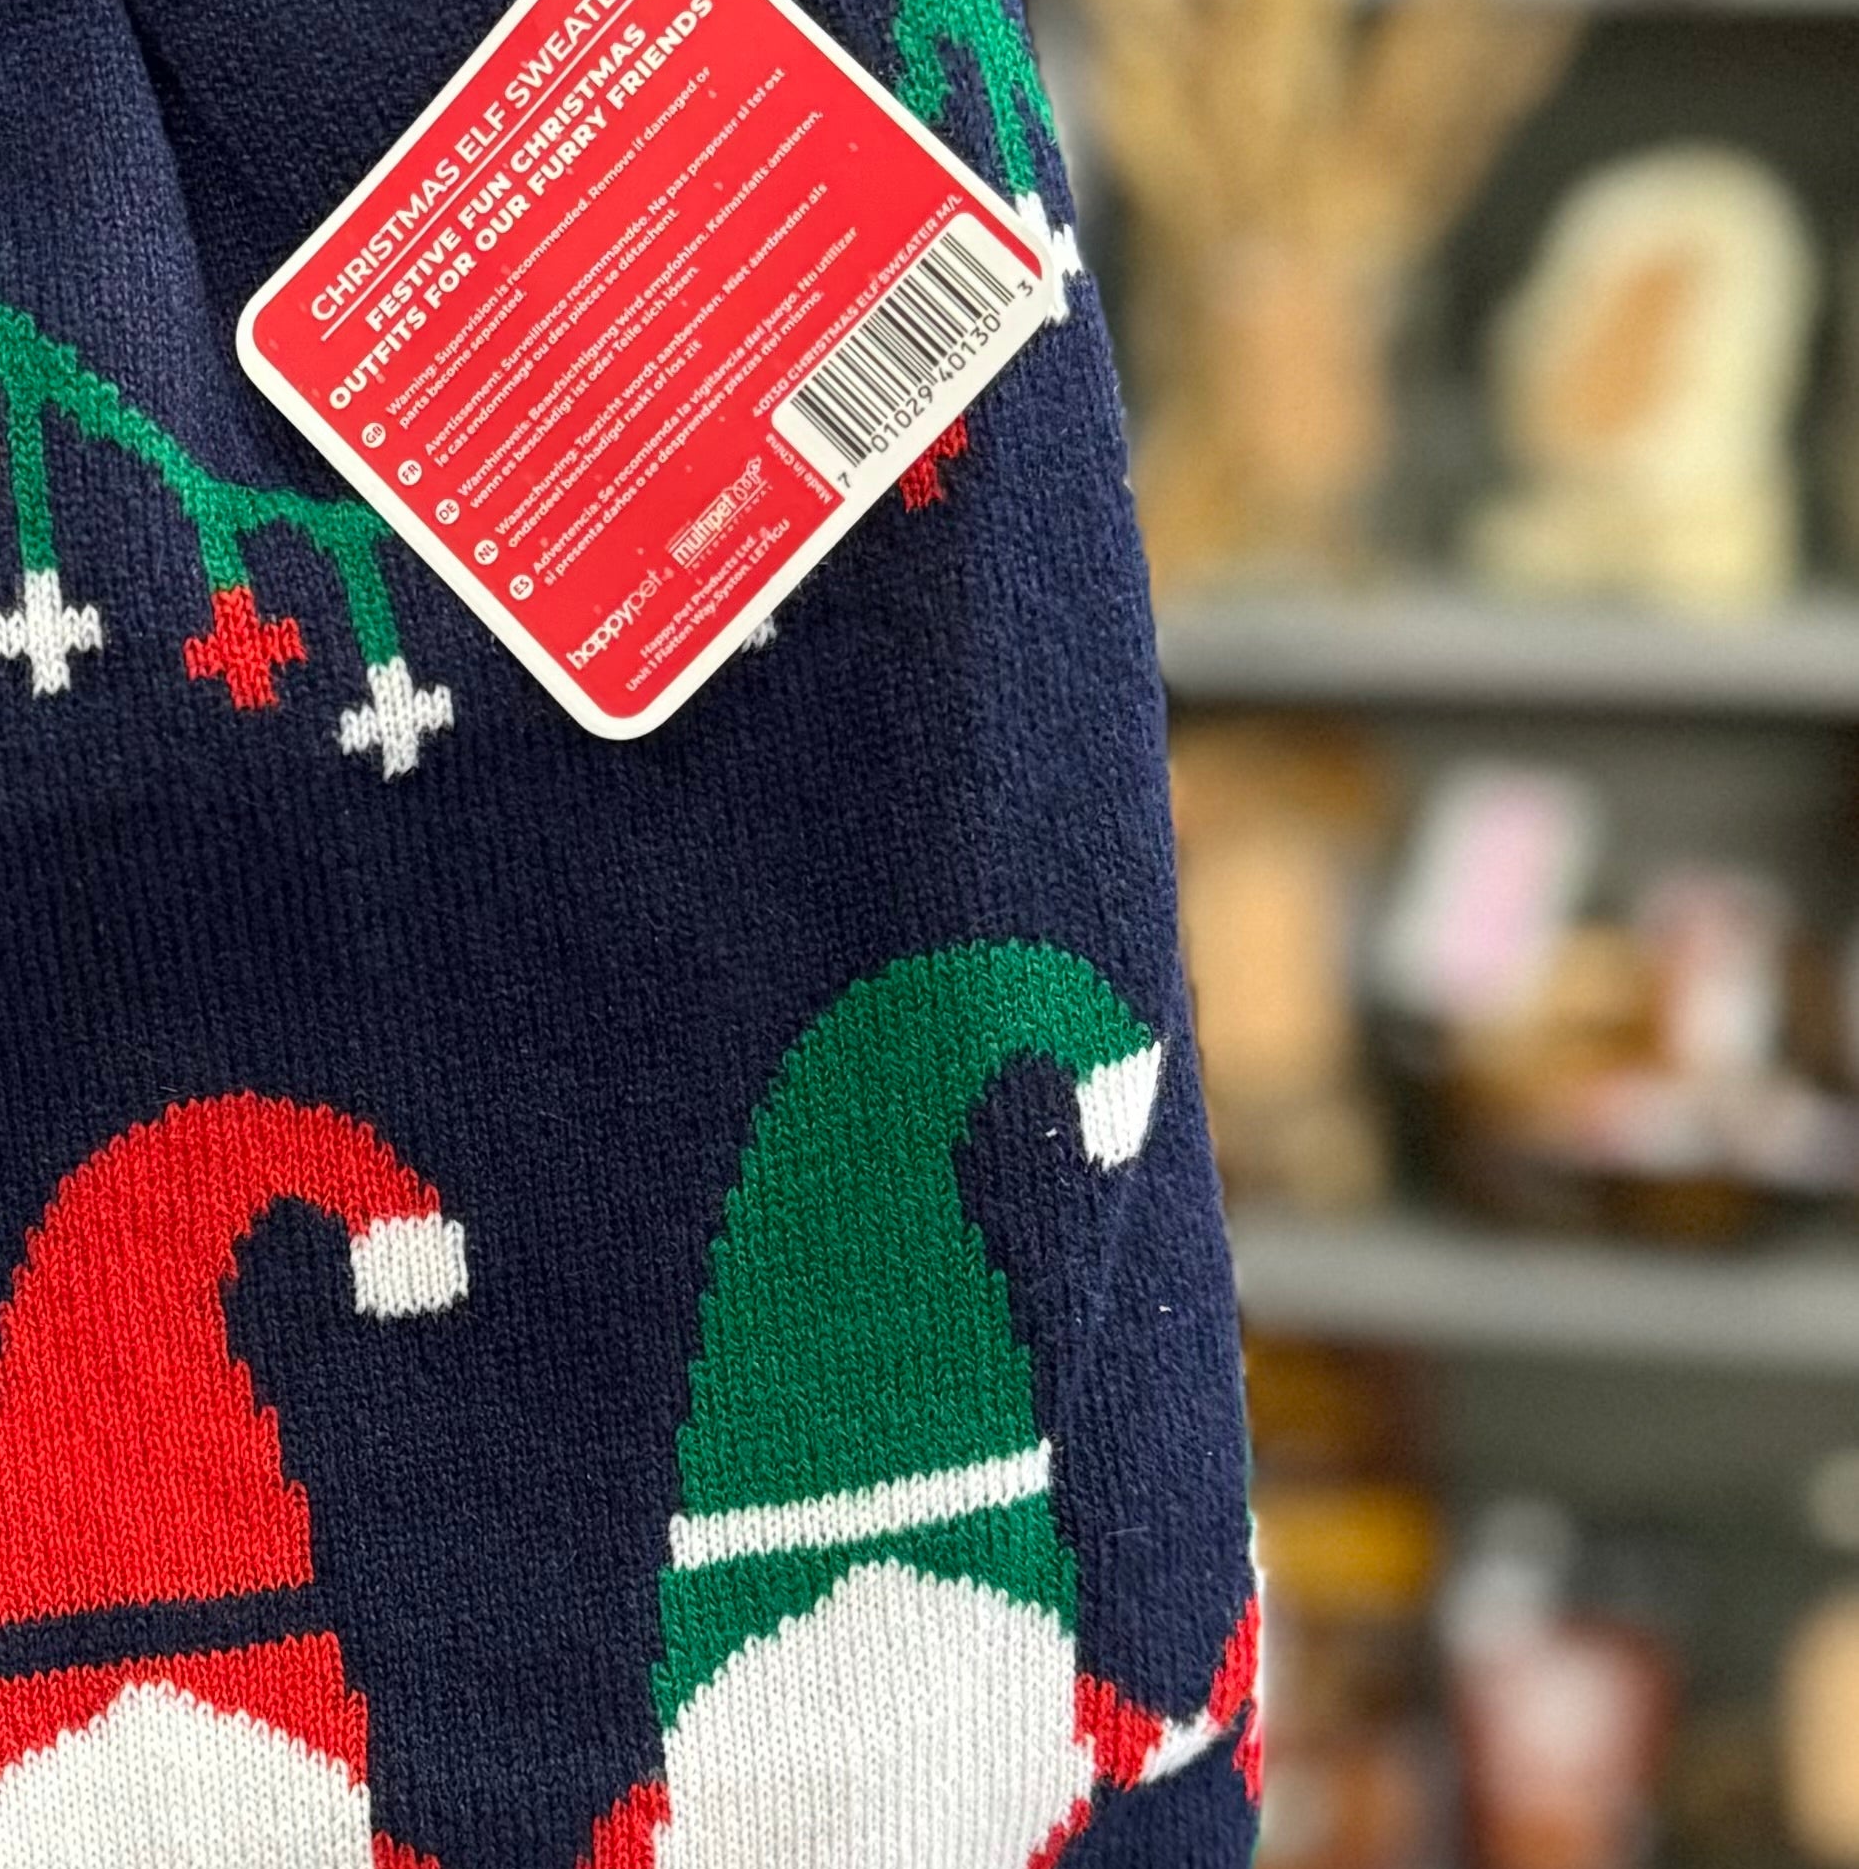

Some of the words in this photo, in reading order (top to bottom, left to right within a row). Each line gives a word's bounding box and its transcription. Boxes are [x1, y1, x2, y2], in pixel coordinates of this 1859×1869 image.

[311, 158, 460, 321] CHRISTMAS
[454, 100, 506, 164] ELF
[329, 305, 427, 410] OUTFITS
[423, 251, 477, 309] FOR
[475, 194, 531, 252] OUR
[526, 105, 607, 196] FURRY
[365, 226, 462, 332] FESTIVE
[457, 171, 513, 230] FUN
[510, 23, 646, 173] CHRISTMAS
[385, 363, 438, 415] Warning:
[434, 295, 499, 365] Supervision
[494, 284, 509, 298] is
[506, 197, 591, 286] recommended.
[587, 149, 636, 200] Remove
[632, 136, 645, 152] if
[643, 79, 698, 141] damaged
[695, 66, 710, 83] or
[425, 370, 504, 456] Avertissement:
[500, 298, 568, 372] Surveillance
[566, 215, 651, 301] recommandée.
[647, 195, 668, 215] Ne
[665, 173, 690, 199] pas
[736, 105, 750, 121] si
[746, 86, 767, 109] tel
[764, 67, 785, 91] est
[399, 395, 430, 430] parts
[425, 349, 472, 398] become
[470, 288, 527, 351] separated.
[433, 453, 450, 468] le
[447, 432, 469, 455] cas
[466, 358, 534, 435] endommagé
[532, 342, 550, 362] ou
[547, 320, 571, 345] des
[567, 283, 607, 325] pièces
[604, 269, 620, 285] se
[618, 208, 679, 271] détachent.
[457, 420, 532, 496] Warnhinweis:
[528, 324, 620, 421] Beaufsichtigung
[614, 295, 646, 326] wird
[643, 233, 709, 299] empfohlen.
[470, 474, 503, 509] wenn
[501, 459, 517, 476] es
[512, 395, 575, 462] beschädigt
[570, 378, 590, 398] ist
[587, 350, 615, 381] oder
[611, 323, 643, 352] Teile
[640, 298, 667, 326] sich
[494, 448, 579, 535] Waarschuwing:
[574, 397, 624, 448] Toezicht
[621, 361, 659, 399] wordt
[808, 183, 828, 205] als
[597, 484, 616, 503] Se
[613, 415, 681, 487] recomienda
[676, 402, 692, 418] la
[815, 226, 857, 274] utilizar
[752, 377, 790, 417] 40130
[786, 305, 859, 381] CHRISTMAS
[855, 278, 880, 309] ELF
[877, 217, 939, 284] SWEATER
[935, 194, 963, 221] M/L
[837, 471, 851, 489] 7
[870, 384, 933, 454] 01029
[935, 312, 1002, 383] 40130
[1017, 279, 1034, 297] 3
[365, 425, 383, 444] GB
[401, 463, 419, 482] FR
[434, 498, 457, 522] DE
[508, 485, 564, 548] onderdeel
[559, 418, 626, 490] beschadigd
[623, 387, 655, 422] raakt
[653, 372, 668, 391] of
[664, 356, 686, 378] los
[683, 339, 703, 359] zit
[544, 569, 557, 586] si
[554, 521, 605, 576] presenta
[602, 485, 638, 524] daños
[635, 476, 647, 488] o
[644, 461, 659, 478] se
[657, 391, 726, 464] desprenden
[760, 331, 782, 356] del
[779, 291, 824, 336] mismo.
[765, 433, 795, 466] China
[792, 460, 807, 477] in
[803, 472, 833, 504] Made
[477, 544, 499, 561] NL
[512, 578, 530, 596] ES
[565, 570, 662, 670] happypet
[640, 621, 676, 664] Happy
[672, 602, 695, 625] Pet
[690, 556, 739, 606] Products
[625, 666, 652, 692] Unit
[647, 659, 658, 669] 1
